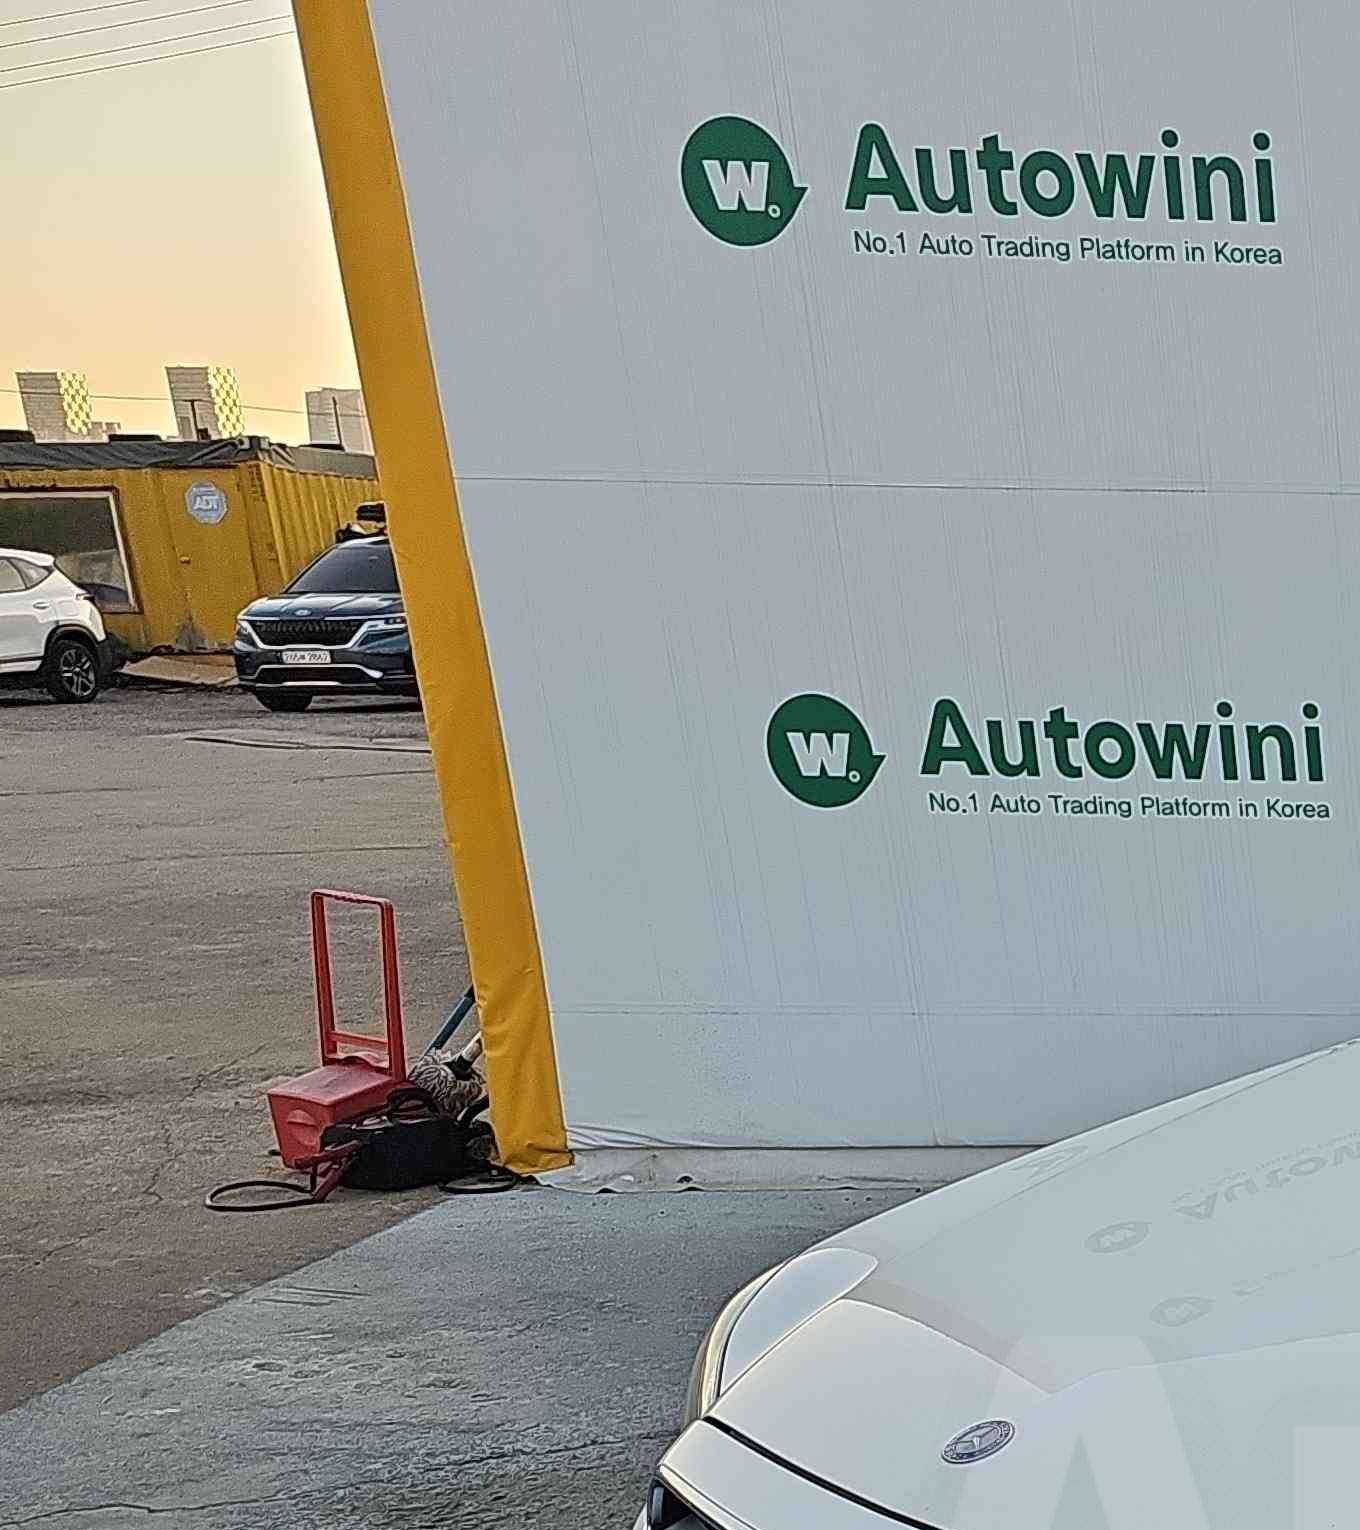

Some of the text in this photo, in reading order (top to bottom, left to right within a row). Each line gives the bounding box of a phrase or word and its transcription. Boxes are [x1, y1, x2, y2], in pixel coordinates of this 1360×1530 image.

[844, 122, 1277, 223] Autowini
[854, 230, 1282, 265] No.1 Auto Trading Platform in Korea
[919, 698, 1324, 782] Autowini
[928, 792, 1330, 819] No.1 Auto Trading Platform in Korea
